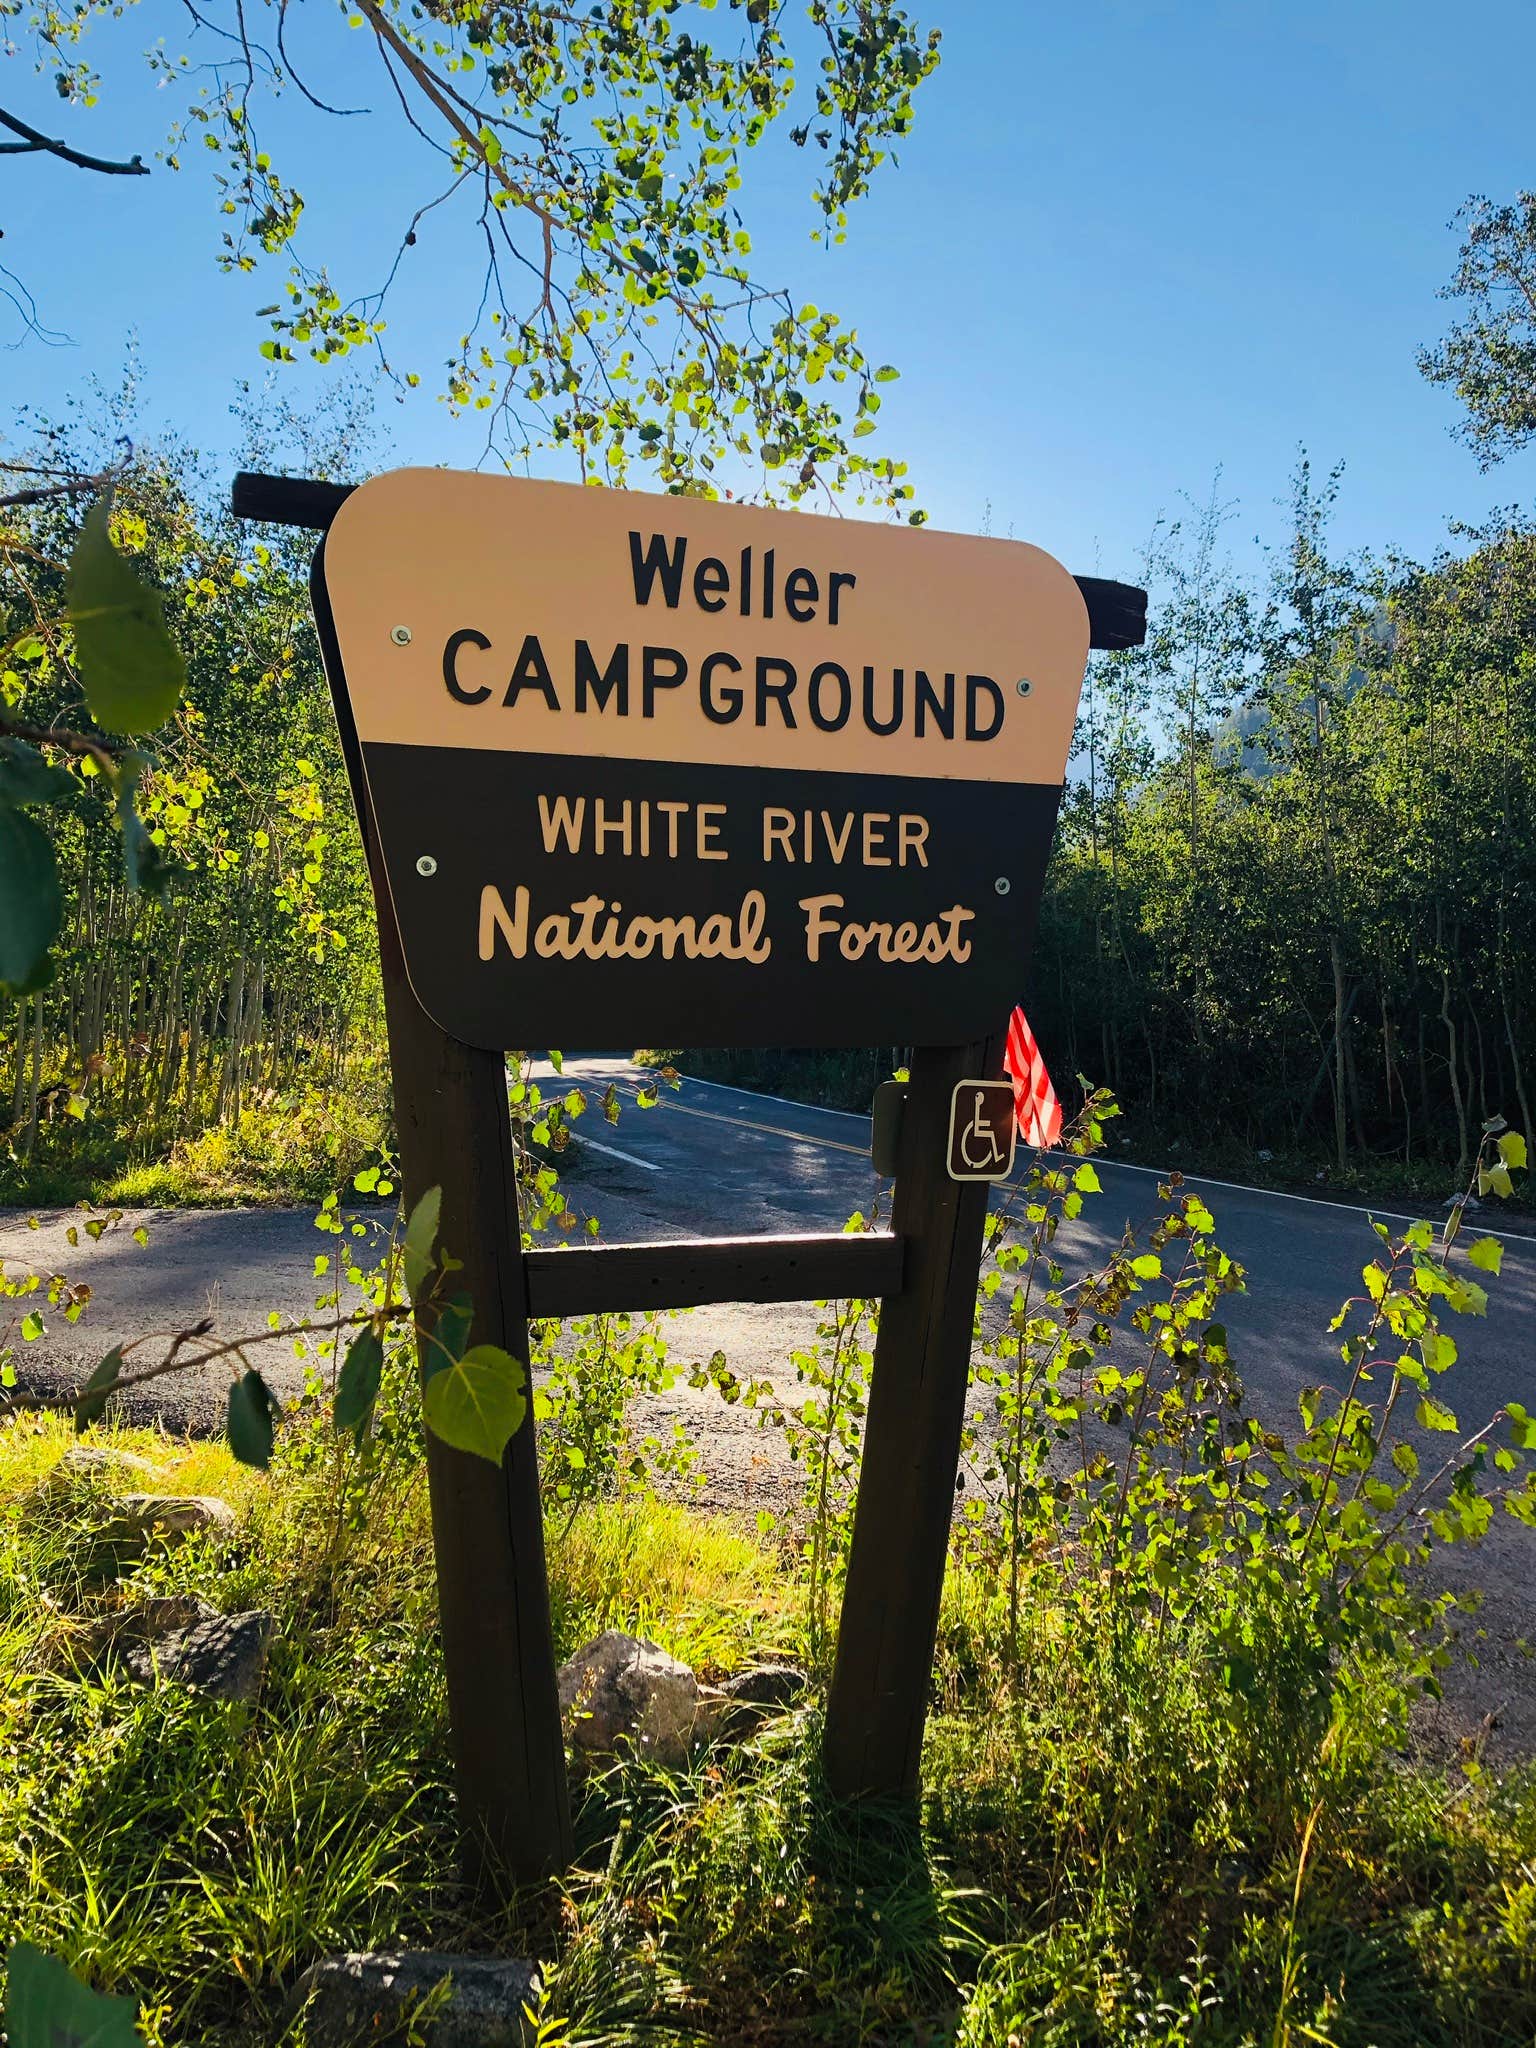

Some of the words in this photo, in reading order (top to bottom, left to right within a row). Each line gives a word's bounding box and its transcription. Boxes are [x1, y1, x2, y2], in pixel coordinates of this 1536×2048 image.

[628, 530, 857, 626] Weller
[442, 628, 1005, 742] CAMPGROUND
[537, 794, 729, 860] WHITE
[763, 807, 930, 868] RIVER
[478, 884, 772, 965] National
[798, 893, 976, 964] Forest
